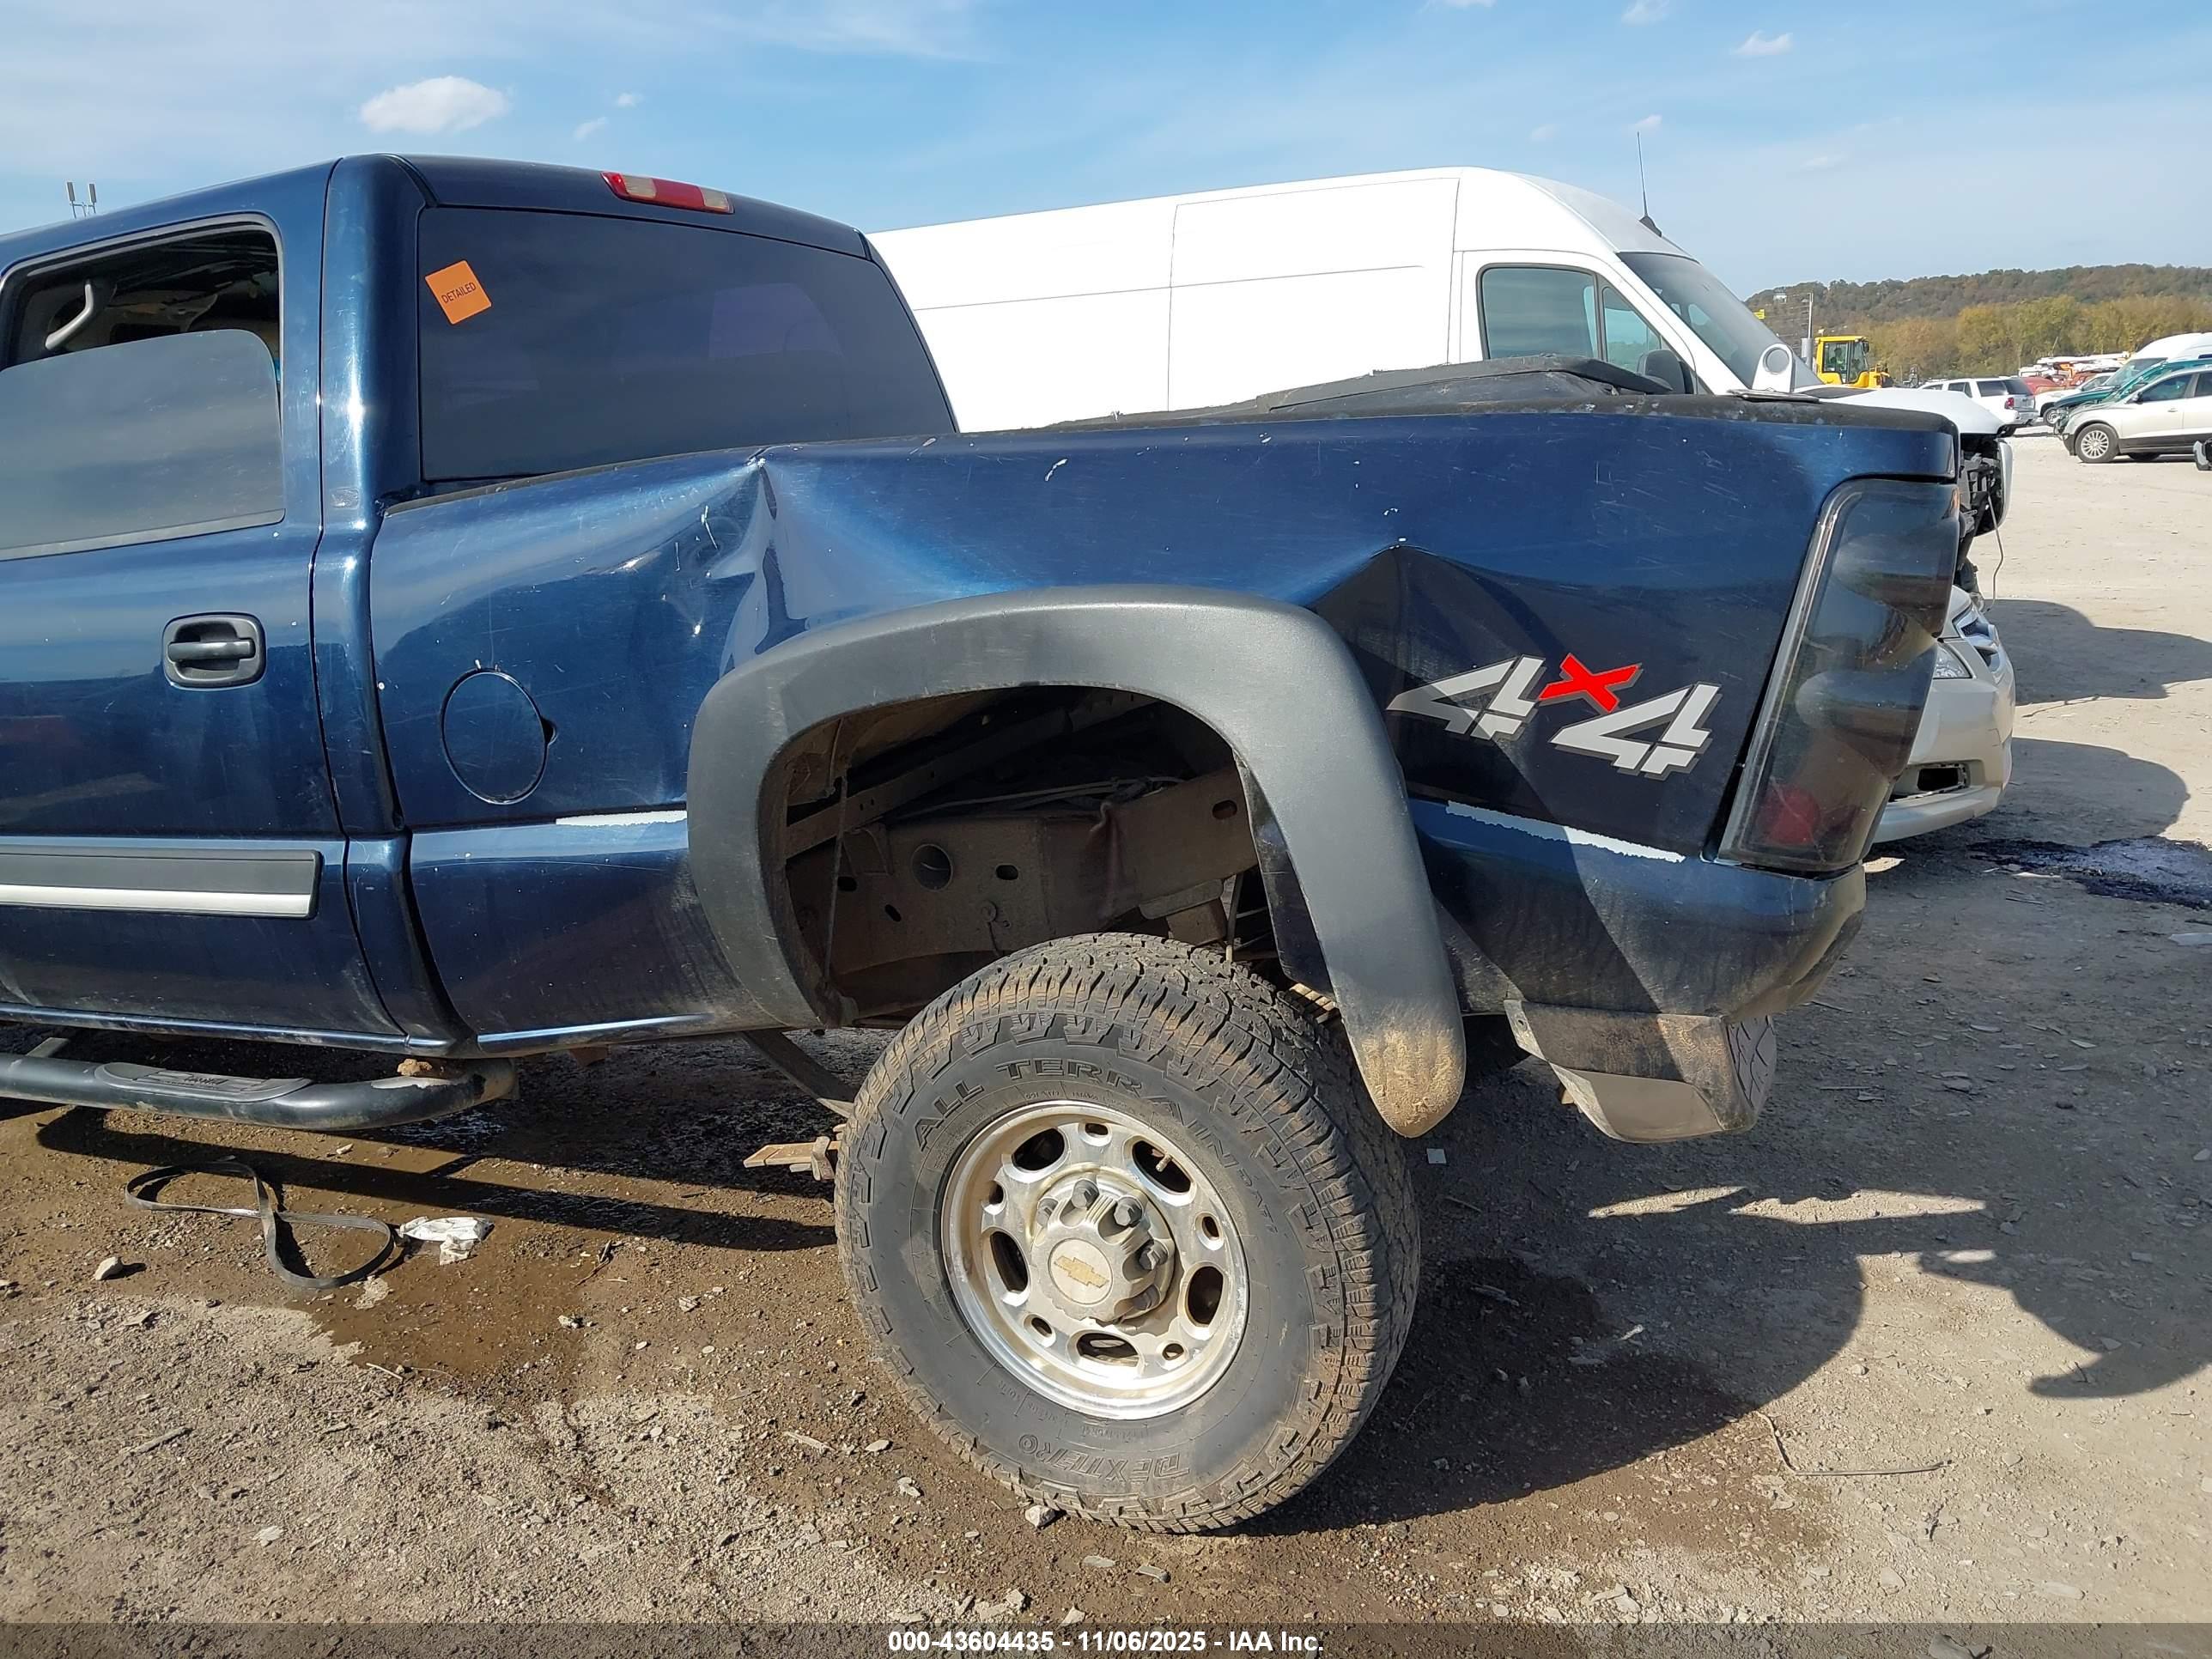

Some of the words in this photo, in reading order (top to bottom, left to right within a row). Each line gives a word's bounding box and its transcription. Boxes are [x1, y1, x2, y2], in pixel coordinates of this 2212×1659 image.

[441, 282, 477, 304] DETAILED
[914, 1079, 985, 1152] ALL
[996, 1057, 1239, 1169] TERRAIN
